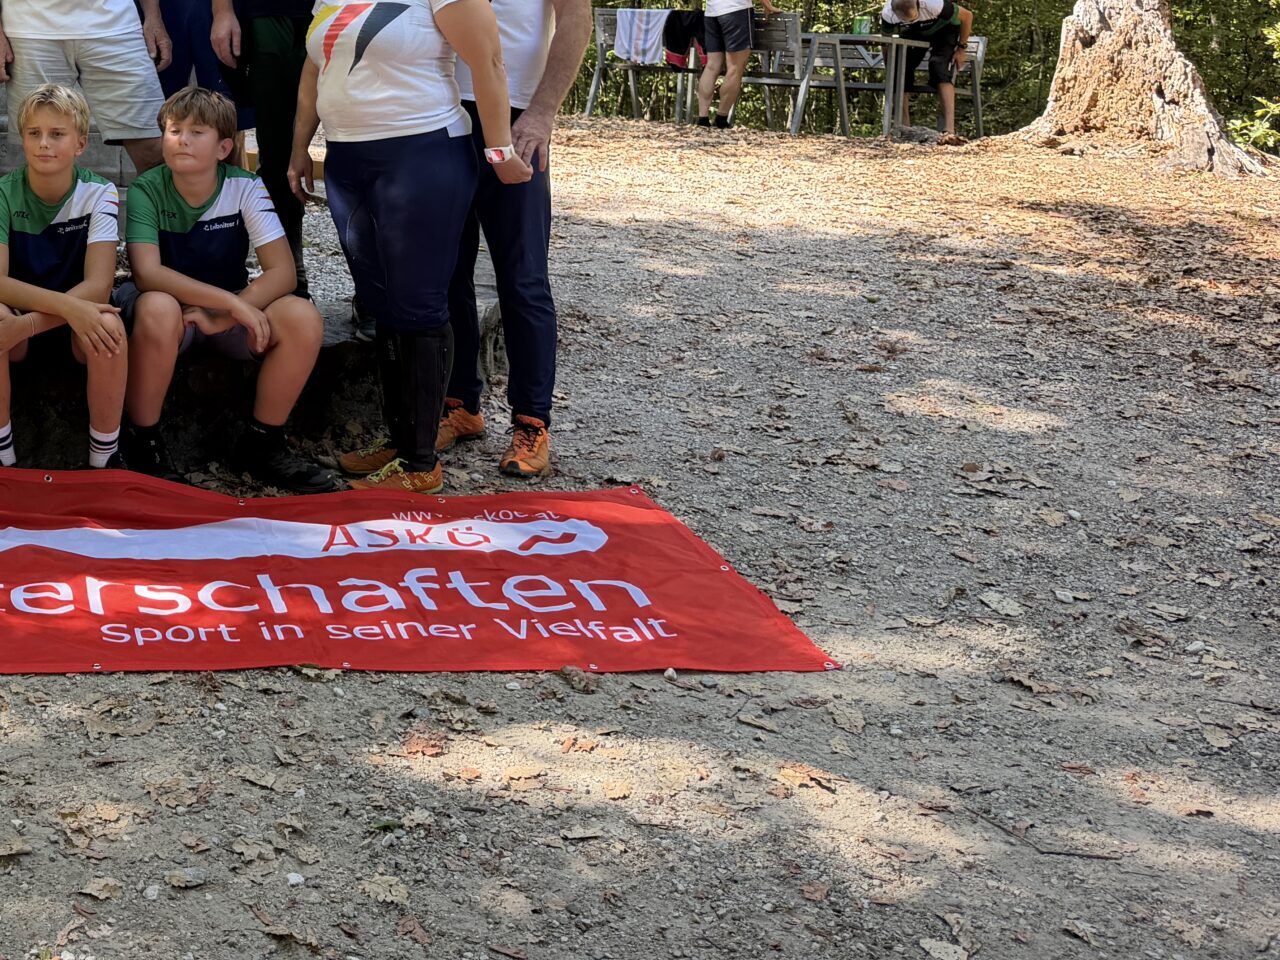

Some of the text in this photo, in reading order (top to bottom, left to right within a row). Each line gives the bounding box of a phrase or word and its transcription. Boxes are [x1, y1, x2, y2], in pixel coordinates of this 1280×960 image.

[321, 524, 491, 552] ASKÖ
[100, 616, 678, 645] Sport in seiner Vielfalt
